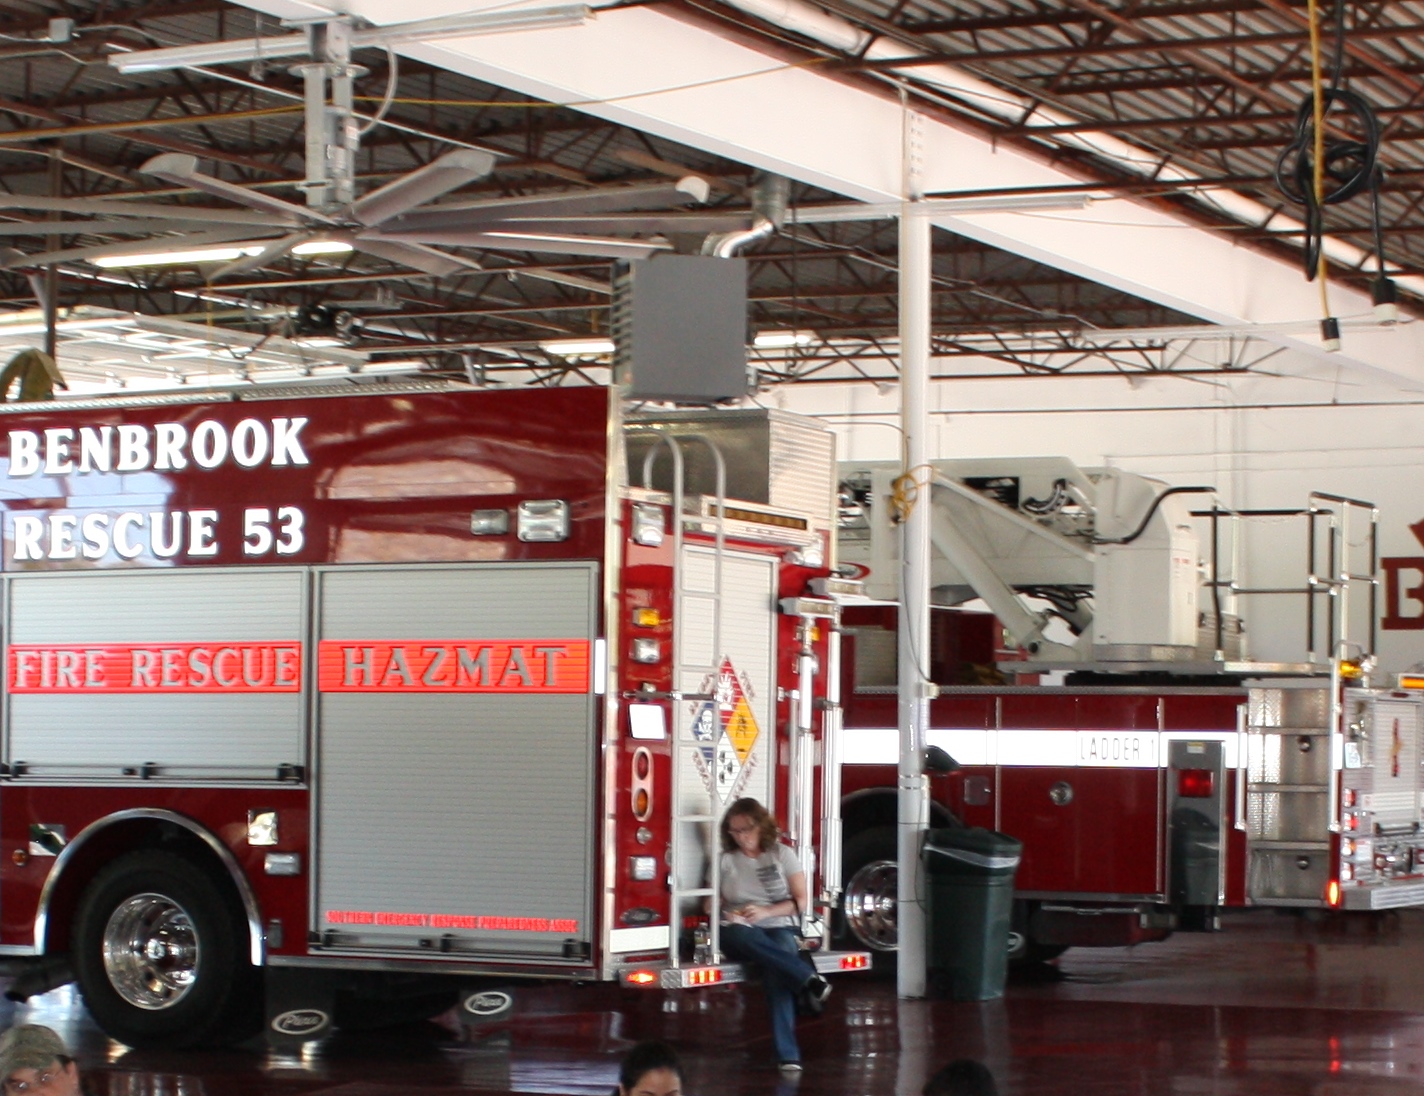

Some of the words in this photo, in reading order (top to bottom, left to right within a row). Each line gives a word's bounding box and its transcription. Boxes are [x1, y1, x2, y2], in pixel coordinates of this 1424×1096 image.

[8, 417, 309, 476] BENBROOK
[12, 509, 218, 560] RESCUE
[243, 506, 304, 556] 53
[14, 648, 106, 688] FIRE
[131, 646, 298, 687] RESCUE
[341, 646, 570, 687] HAZMAT
[1080, 737, 1140, 761] LADDER
